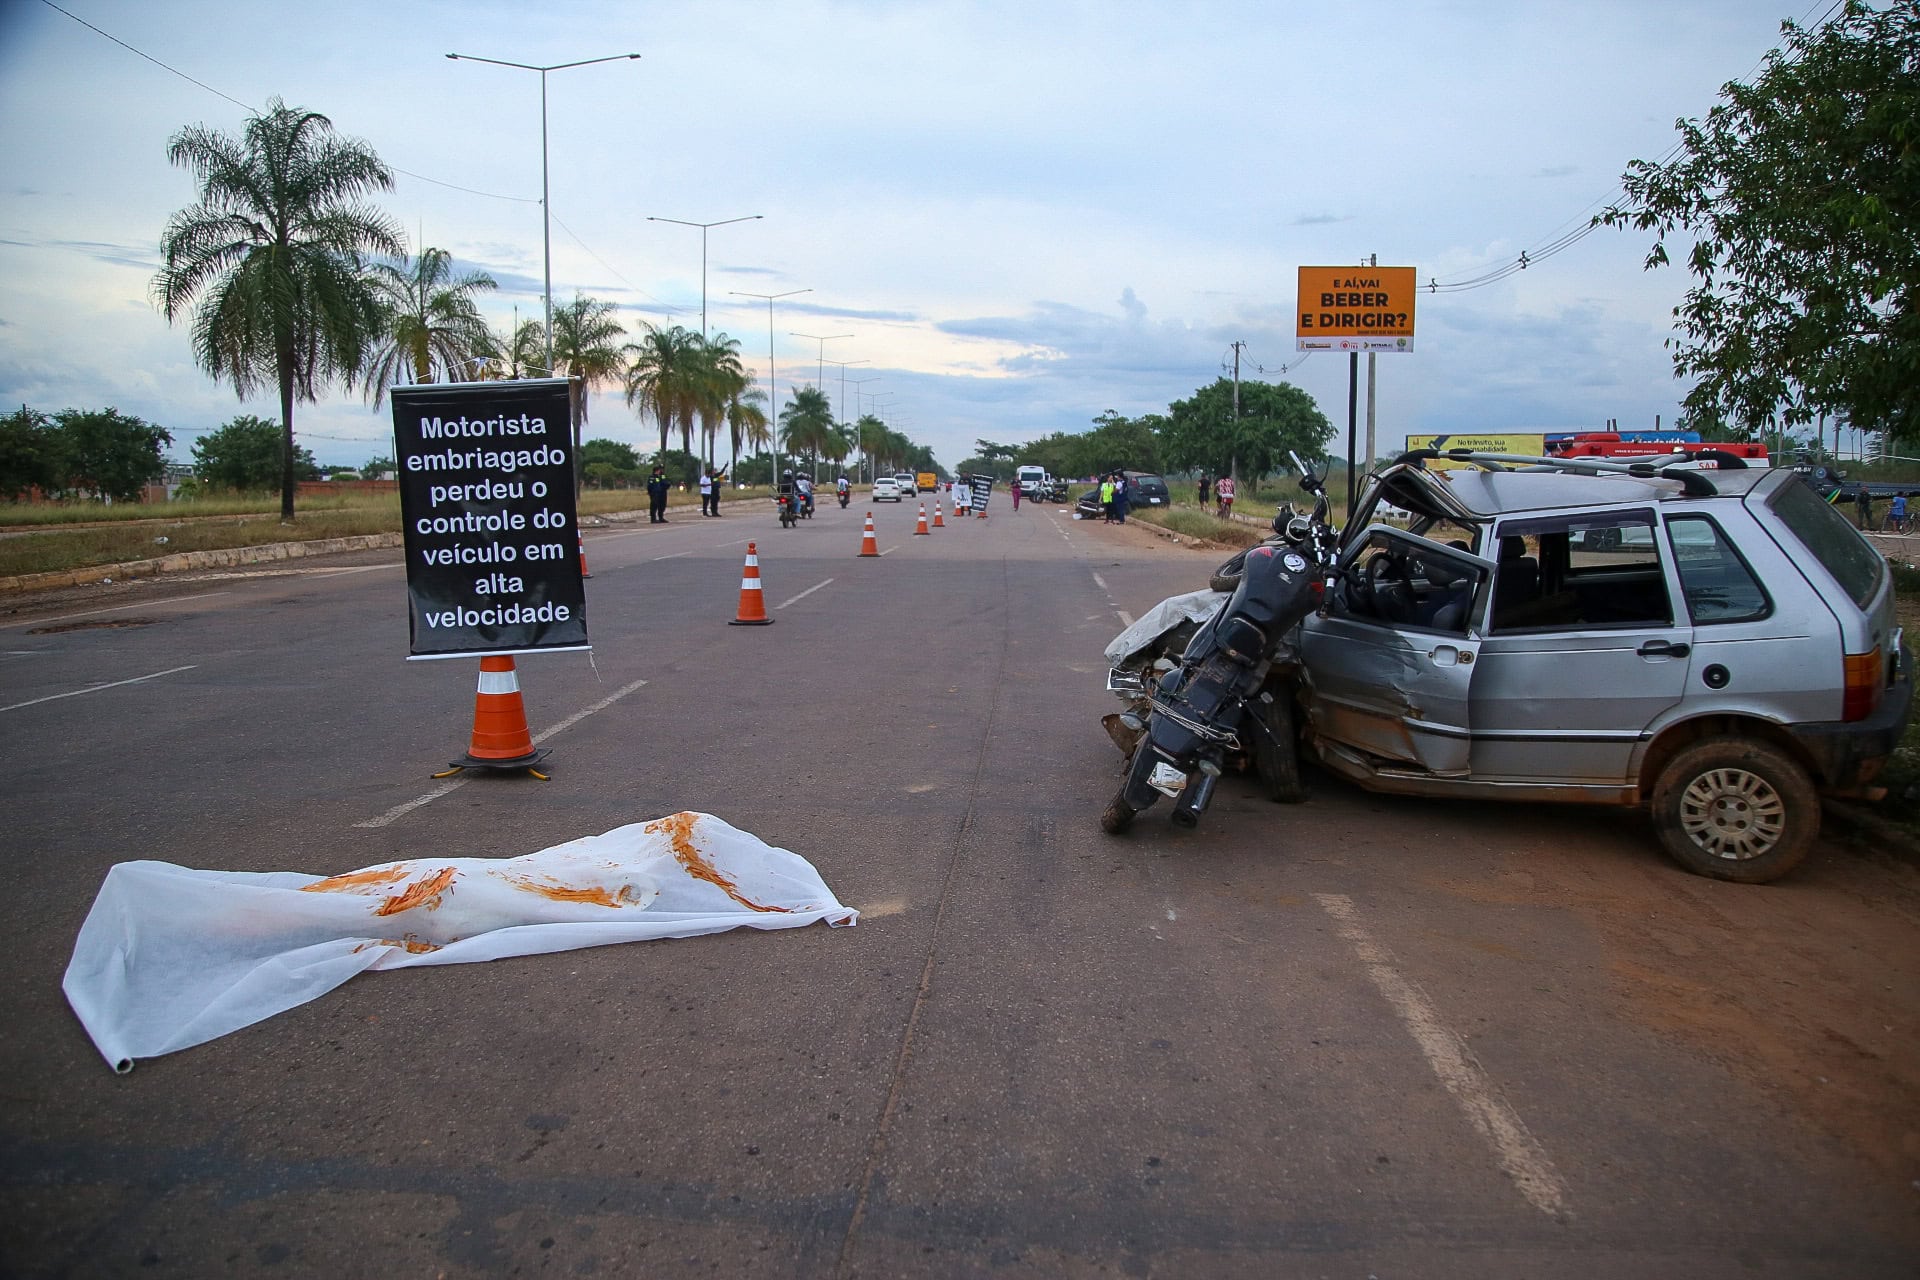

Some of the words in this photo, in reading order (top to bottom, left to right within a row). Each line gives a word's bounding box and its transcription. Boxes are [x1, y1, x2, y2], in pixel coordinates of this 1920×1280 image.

[1333, 279, 1341, 288] E
[1321, 292, 1389, 307] BEBER
[1301, 313, 1313, 328] E
[1319, 313, 1407, 328] DIRIGIR?
[420, 413, 547, 440] Motorista
[407, 444, 566, 473] embriagado
[430, 479, 524, 508] perdeu
[531, 480, 548, 498] o
[416, 509, 526, 535] controle
[533, 507, 566, 530] do
[423, 541, 517, 566] veículo
[524, 542, 564, 561] em
[475, 572, 524, 595] alta
[425, 601, 570, 628] velocidade
